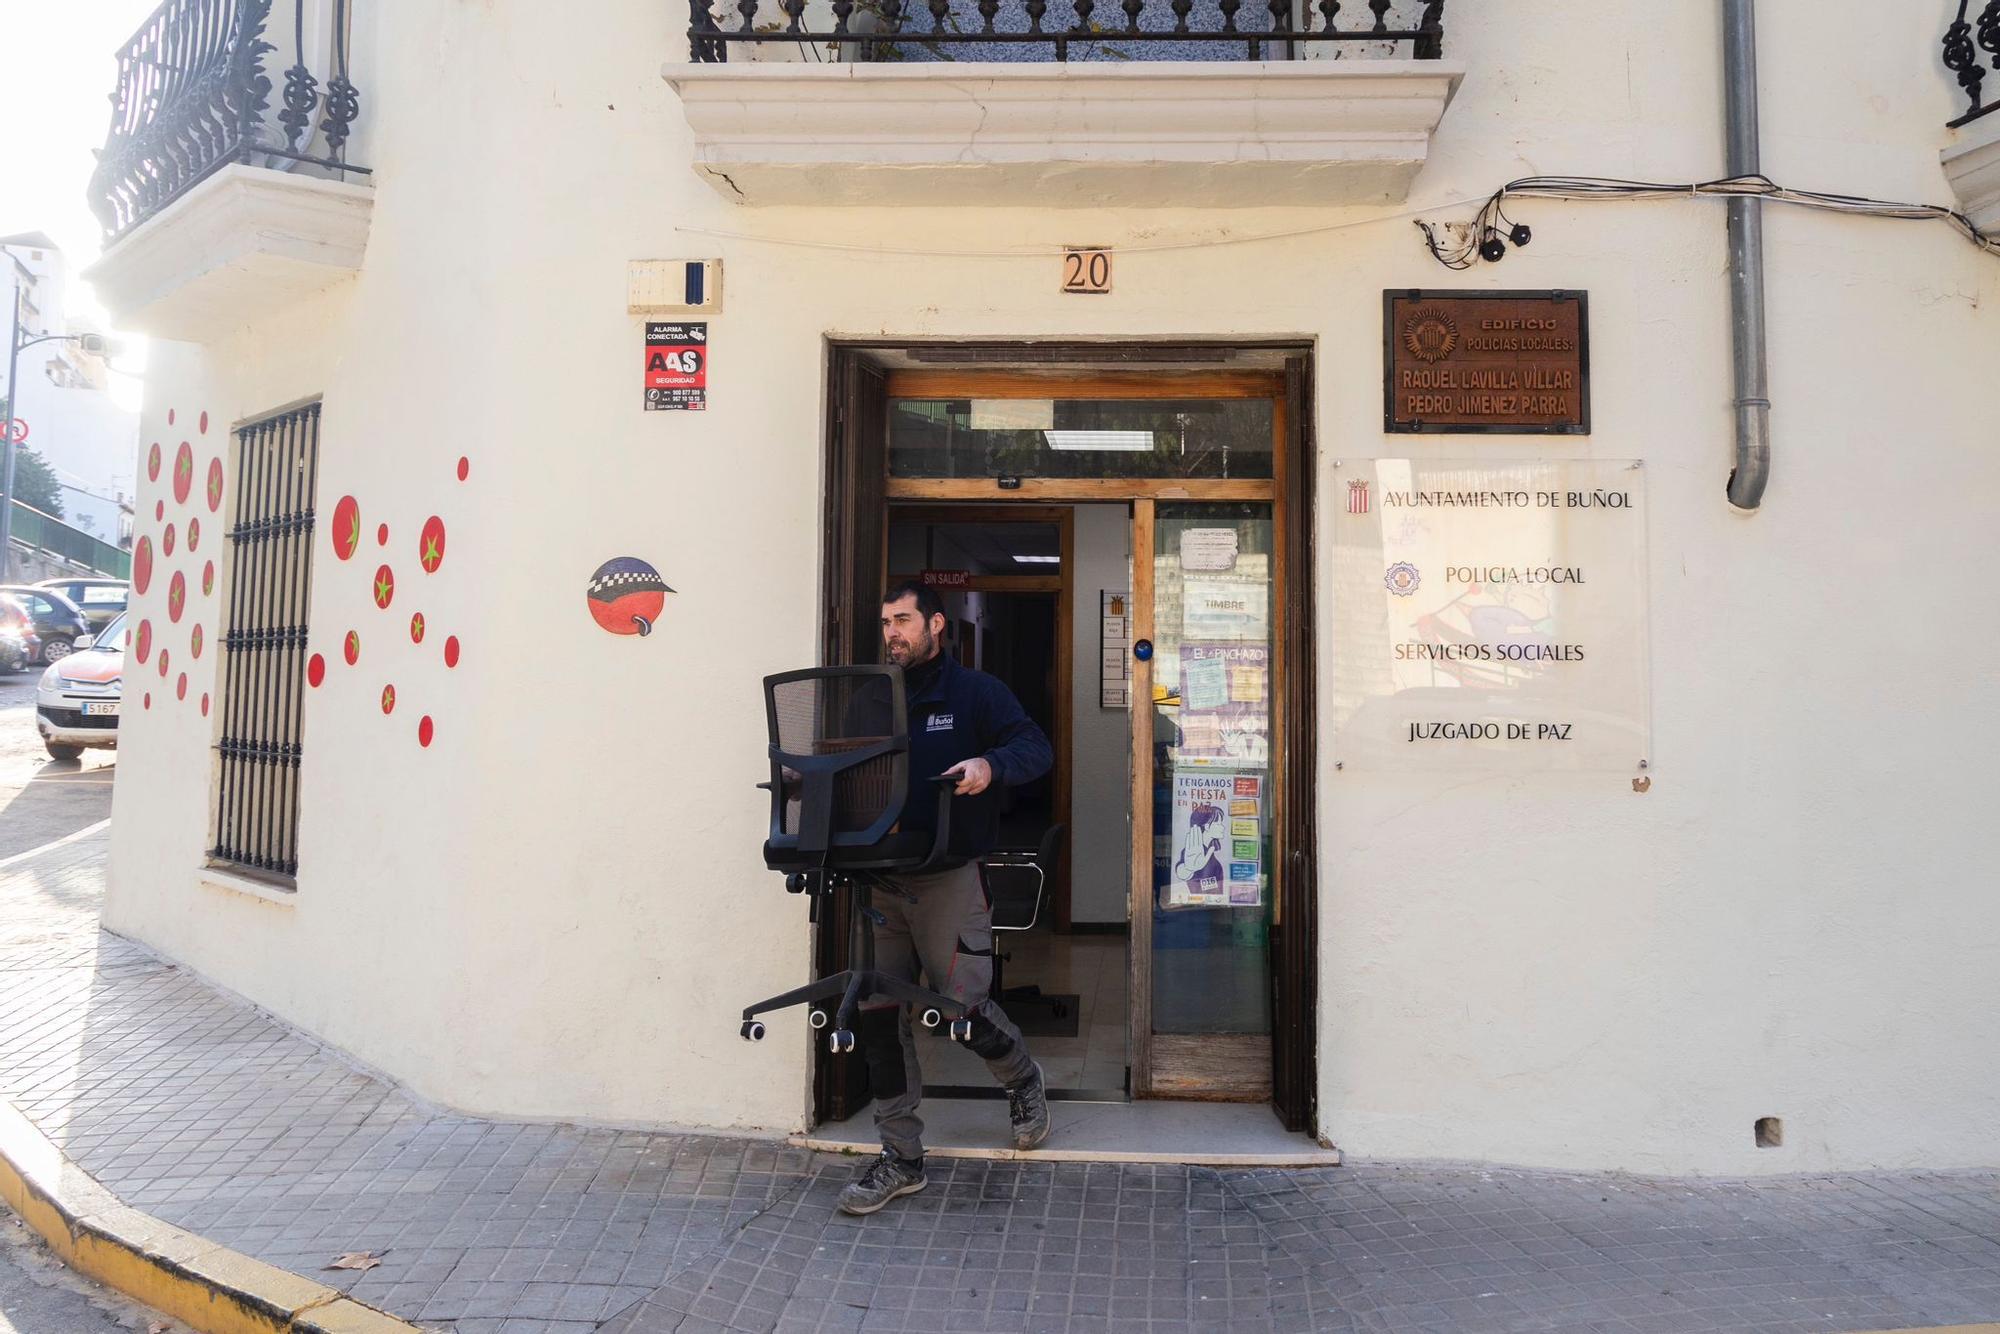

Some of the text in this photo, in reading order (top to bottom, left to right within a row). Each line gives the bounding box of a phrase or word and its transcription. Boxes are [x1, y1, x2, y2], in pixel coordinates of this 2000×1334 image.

[1066, 252, 1109, 287] 20
[1480, 319, 1558, 331] EDIFICIO
[1466, 338, 1519, 351] POLICIAS
[647, 350, 698, 373] AAS
[1402, 370, 1573, 390] RAQUEL LAVILLA VILLAR
[1407, 395, 1568, 415] PEDRO JIMENEZ PARRA
[1383, 488, 1633, 508] AYUNTAMIENTO DE BUÑOL
[925, 573, 965, 585] SIN SALIDA
[1446, 566, 1586, 584] POLICIA LOCAL
[1204, 599, 1246, 610] TIMBRE
[1193, 647, 1264, 660] EL PINCHAZO
[1394, 643, 1585, 662] SERVICIOS SOCIALES
[89, 704, 115, 713] 5167
[1408, 722, 1573, 742] JUZGADO DE PAZ
[1179, 777, 1232, 788] TENGAMOS
[1190, 788, 1227, 801] FIESTA
